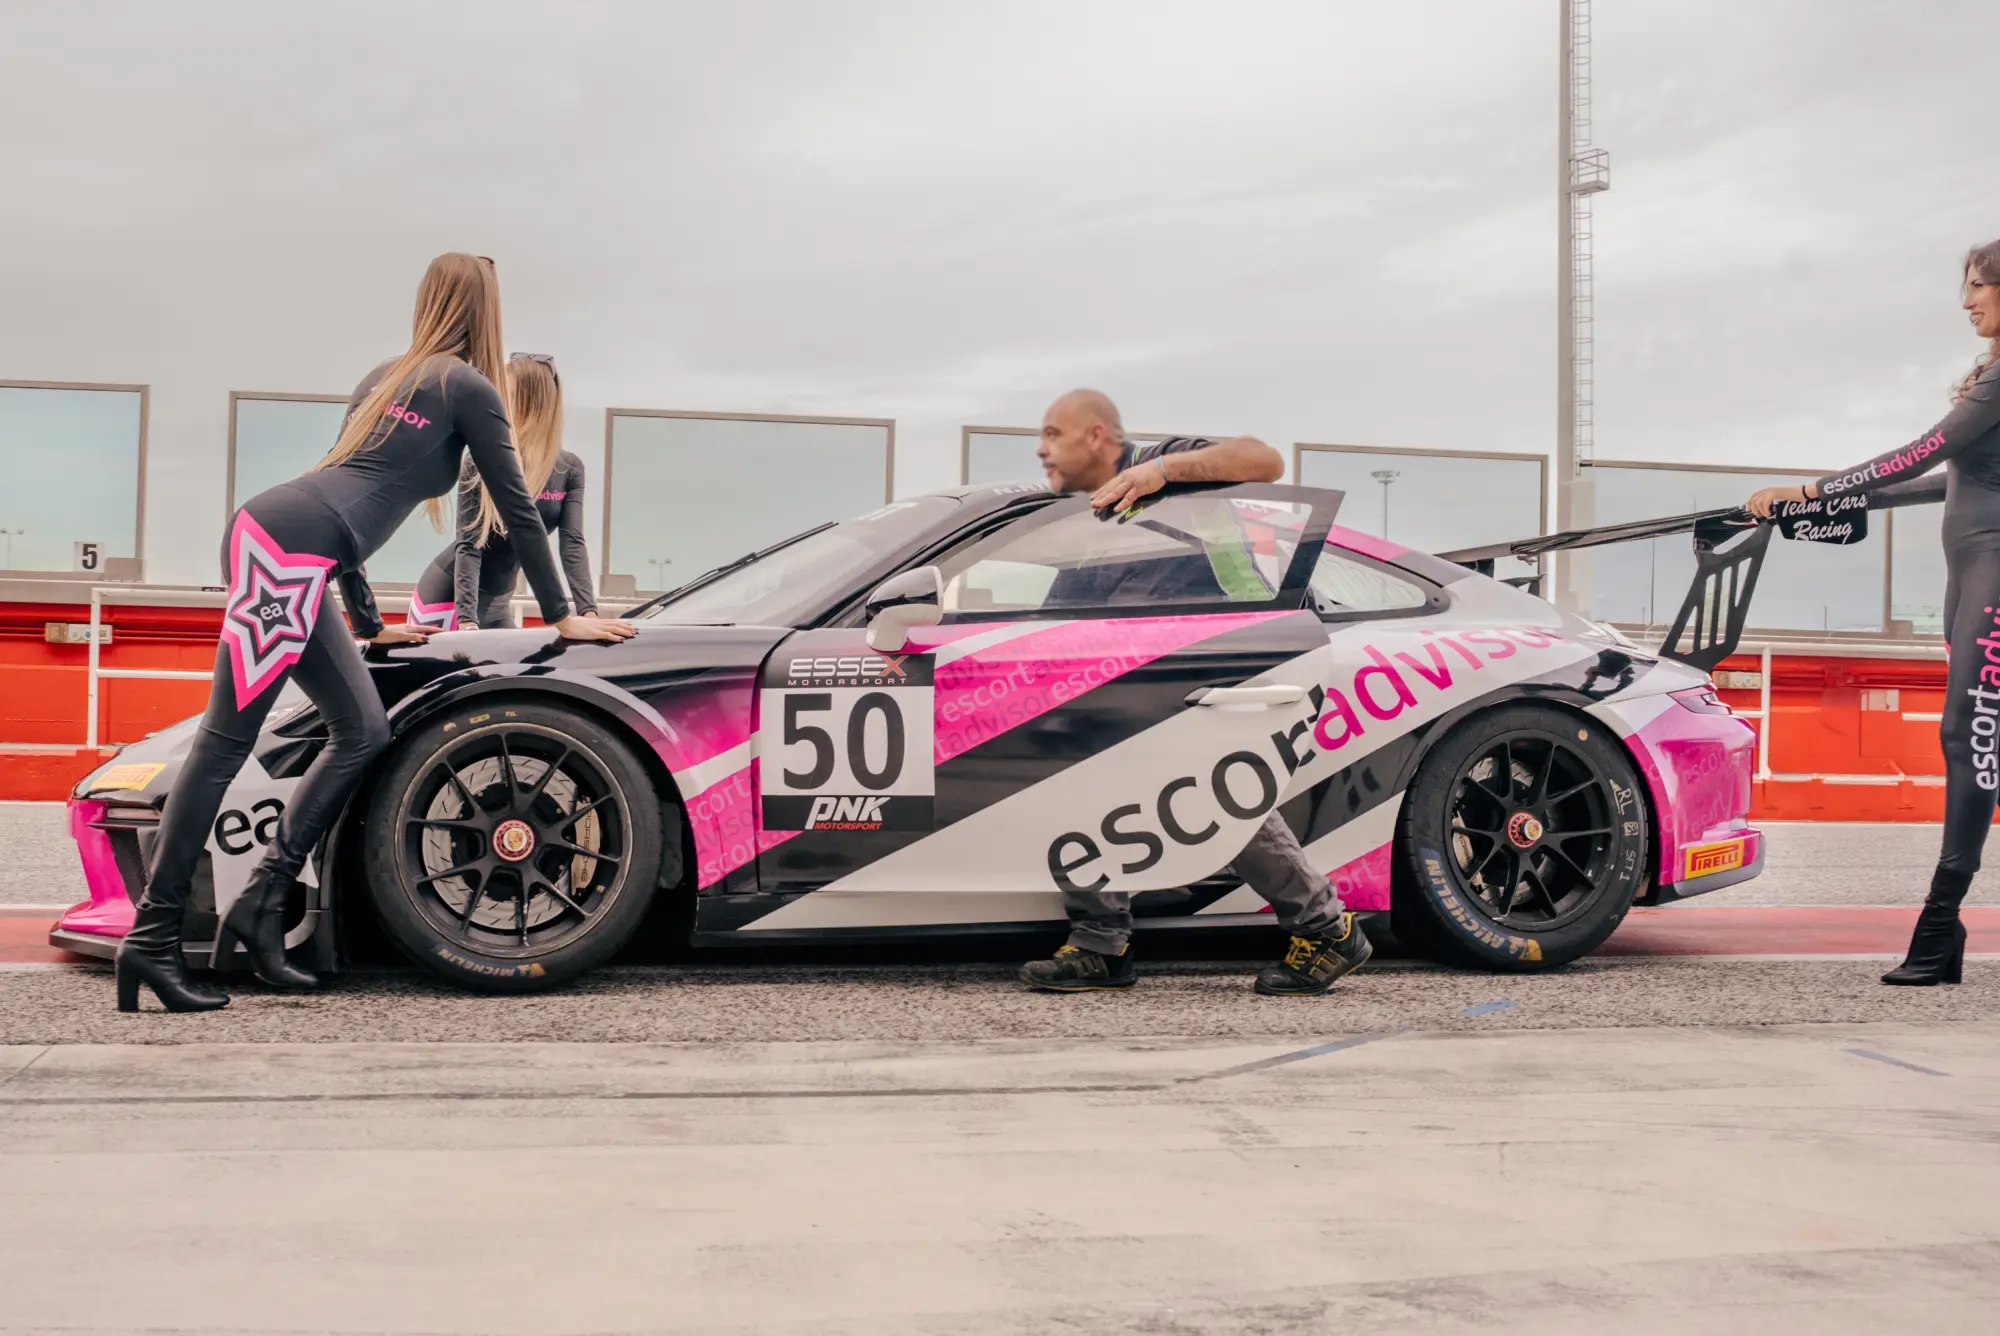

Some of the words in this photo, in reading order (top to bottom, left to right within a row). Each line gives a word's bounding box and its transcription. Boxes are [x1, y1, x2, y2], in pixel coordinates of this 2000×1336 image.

[1823, 429, 1947, 495] escortadvisor
[1781, 498, 1823, 518] Team
[1826, 492, 1868, 516] Cars
[1793, 519, 1853, 546] Racing
[81, 542, 98, 570] 5
[259, 602, 284, 621] ea
[788, 655, 909, 678] ESSEX
[787, 677, 908, 687] MOTORSPORT
[783, 691, 906, 791] 50
[214, 798, 286, 856] ea
[814, 822, 883, 831] MOTORSPORT
[1690, 843, 1739, 873] PIRELLI
[1424, 858, 1506, 950] MICHELIN
[436, 948, 516, 978] MICHELIN
